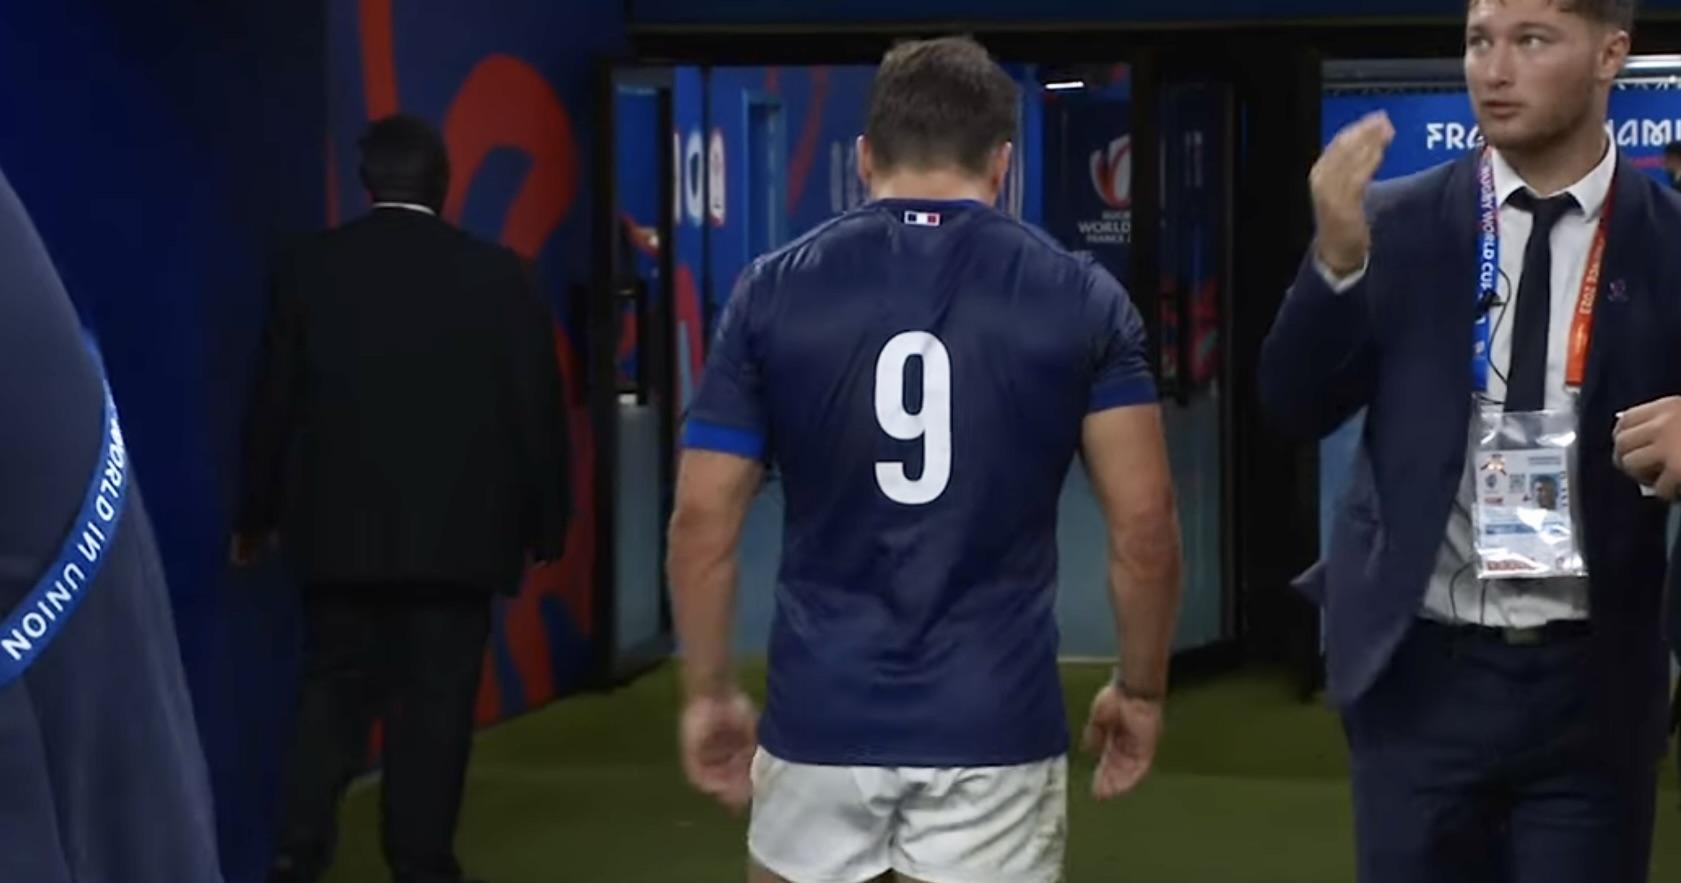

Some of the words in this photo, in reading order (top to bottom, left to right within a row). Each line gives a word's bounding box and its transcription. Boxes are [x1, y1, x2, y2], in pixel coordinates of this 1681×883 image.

[1427, 122, 1484, 149] FRA
[1607, 119, 1681, 146] AM
[1078, 221, 1130, 233] WORLD
[1481, 211, 1495, 260] WORLD
[875, 331, 952, 504] 9
[76, 522, 105, 563] IN
[1, 562, 86, 660] UNION
